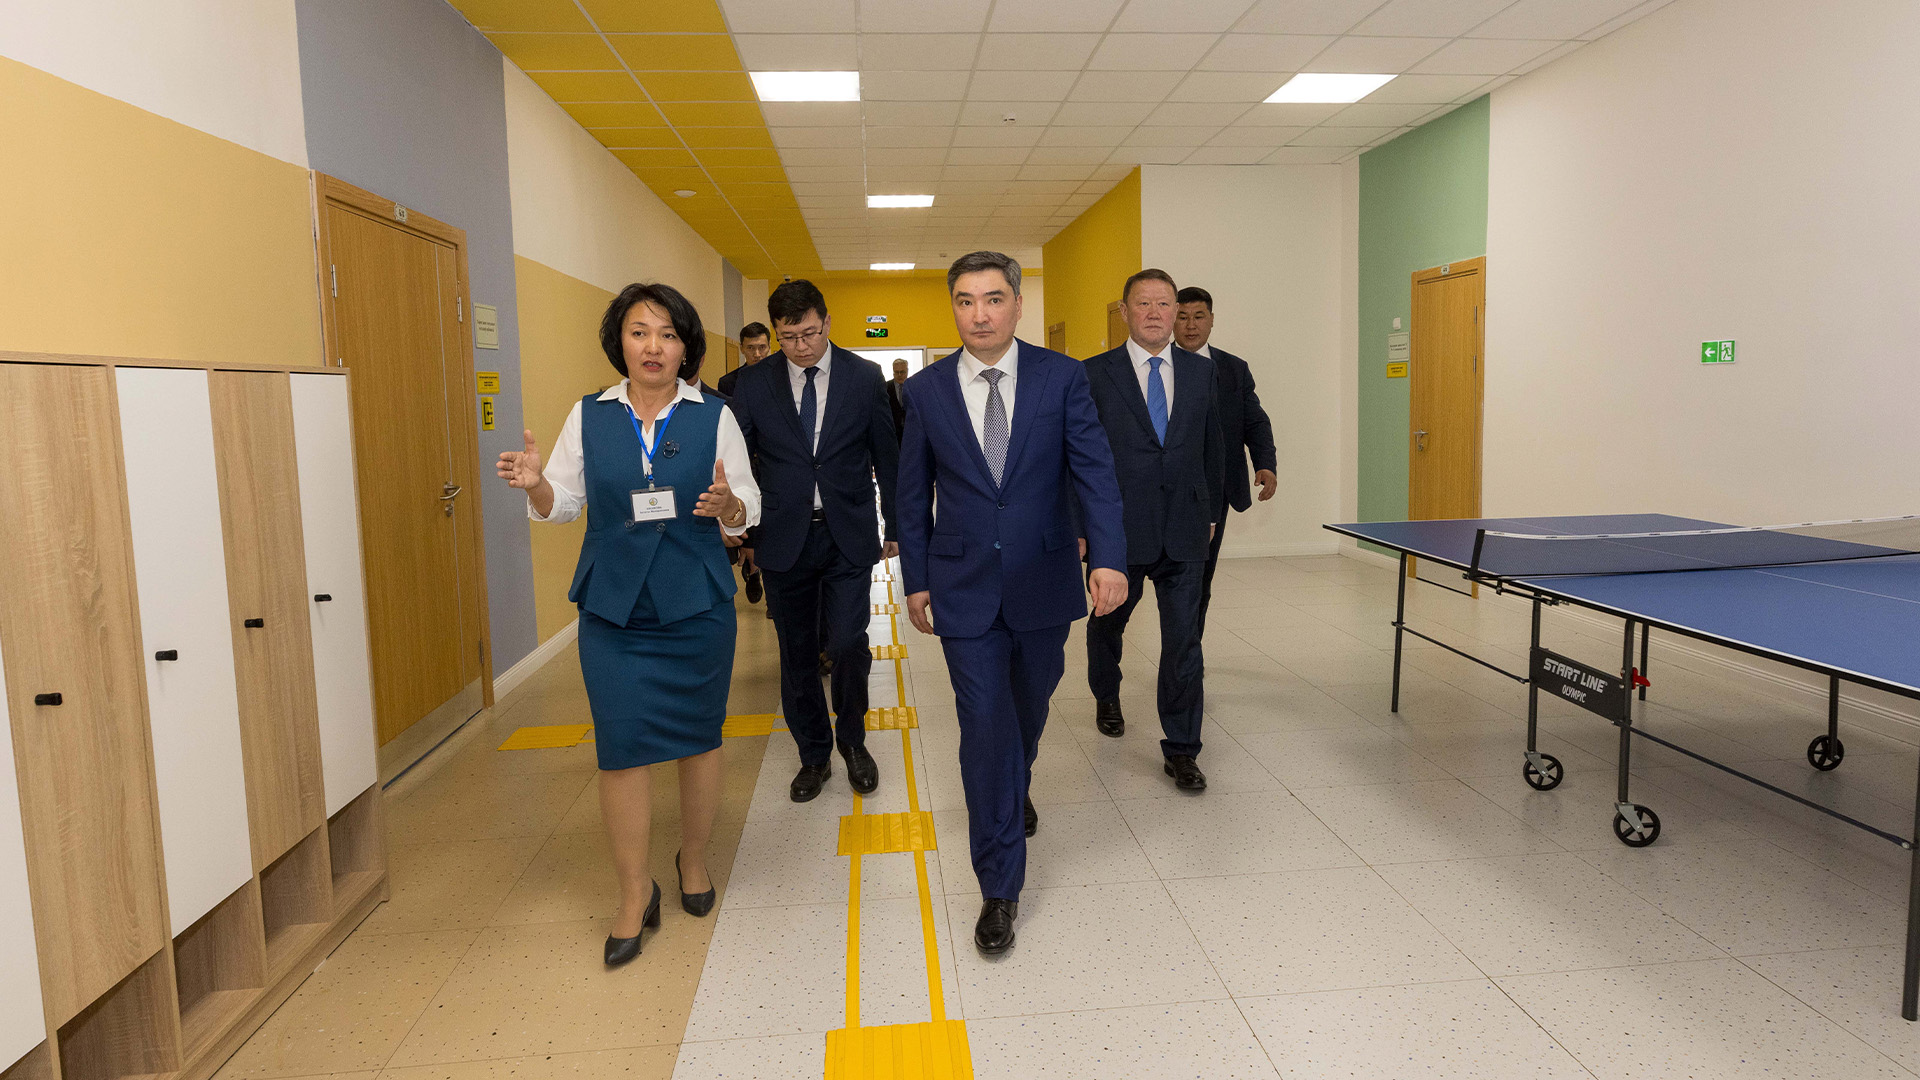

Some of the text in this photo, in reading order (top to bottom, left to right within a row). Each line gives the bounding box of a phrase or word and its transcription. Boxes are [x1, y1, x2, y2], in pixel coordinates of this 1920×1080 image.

[1543, 657, 1606, 694] START LINE
[1562, 684, 1587, 703] OLYMPIC
